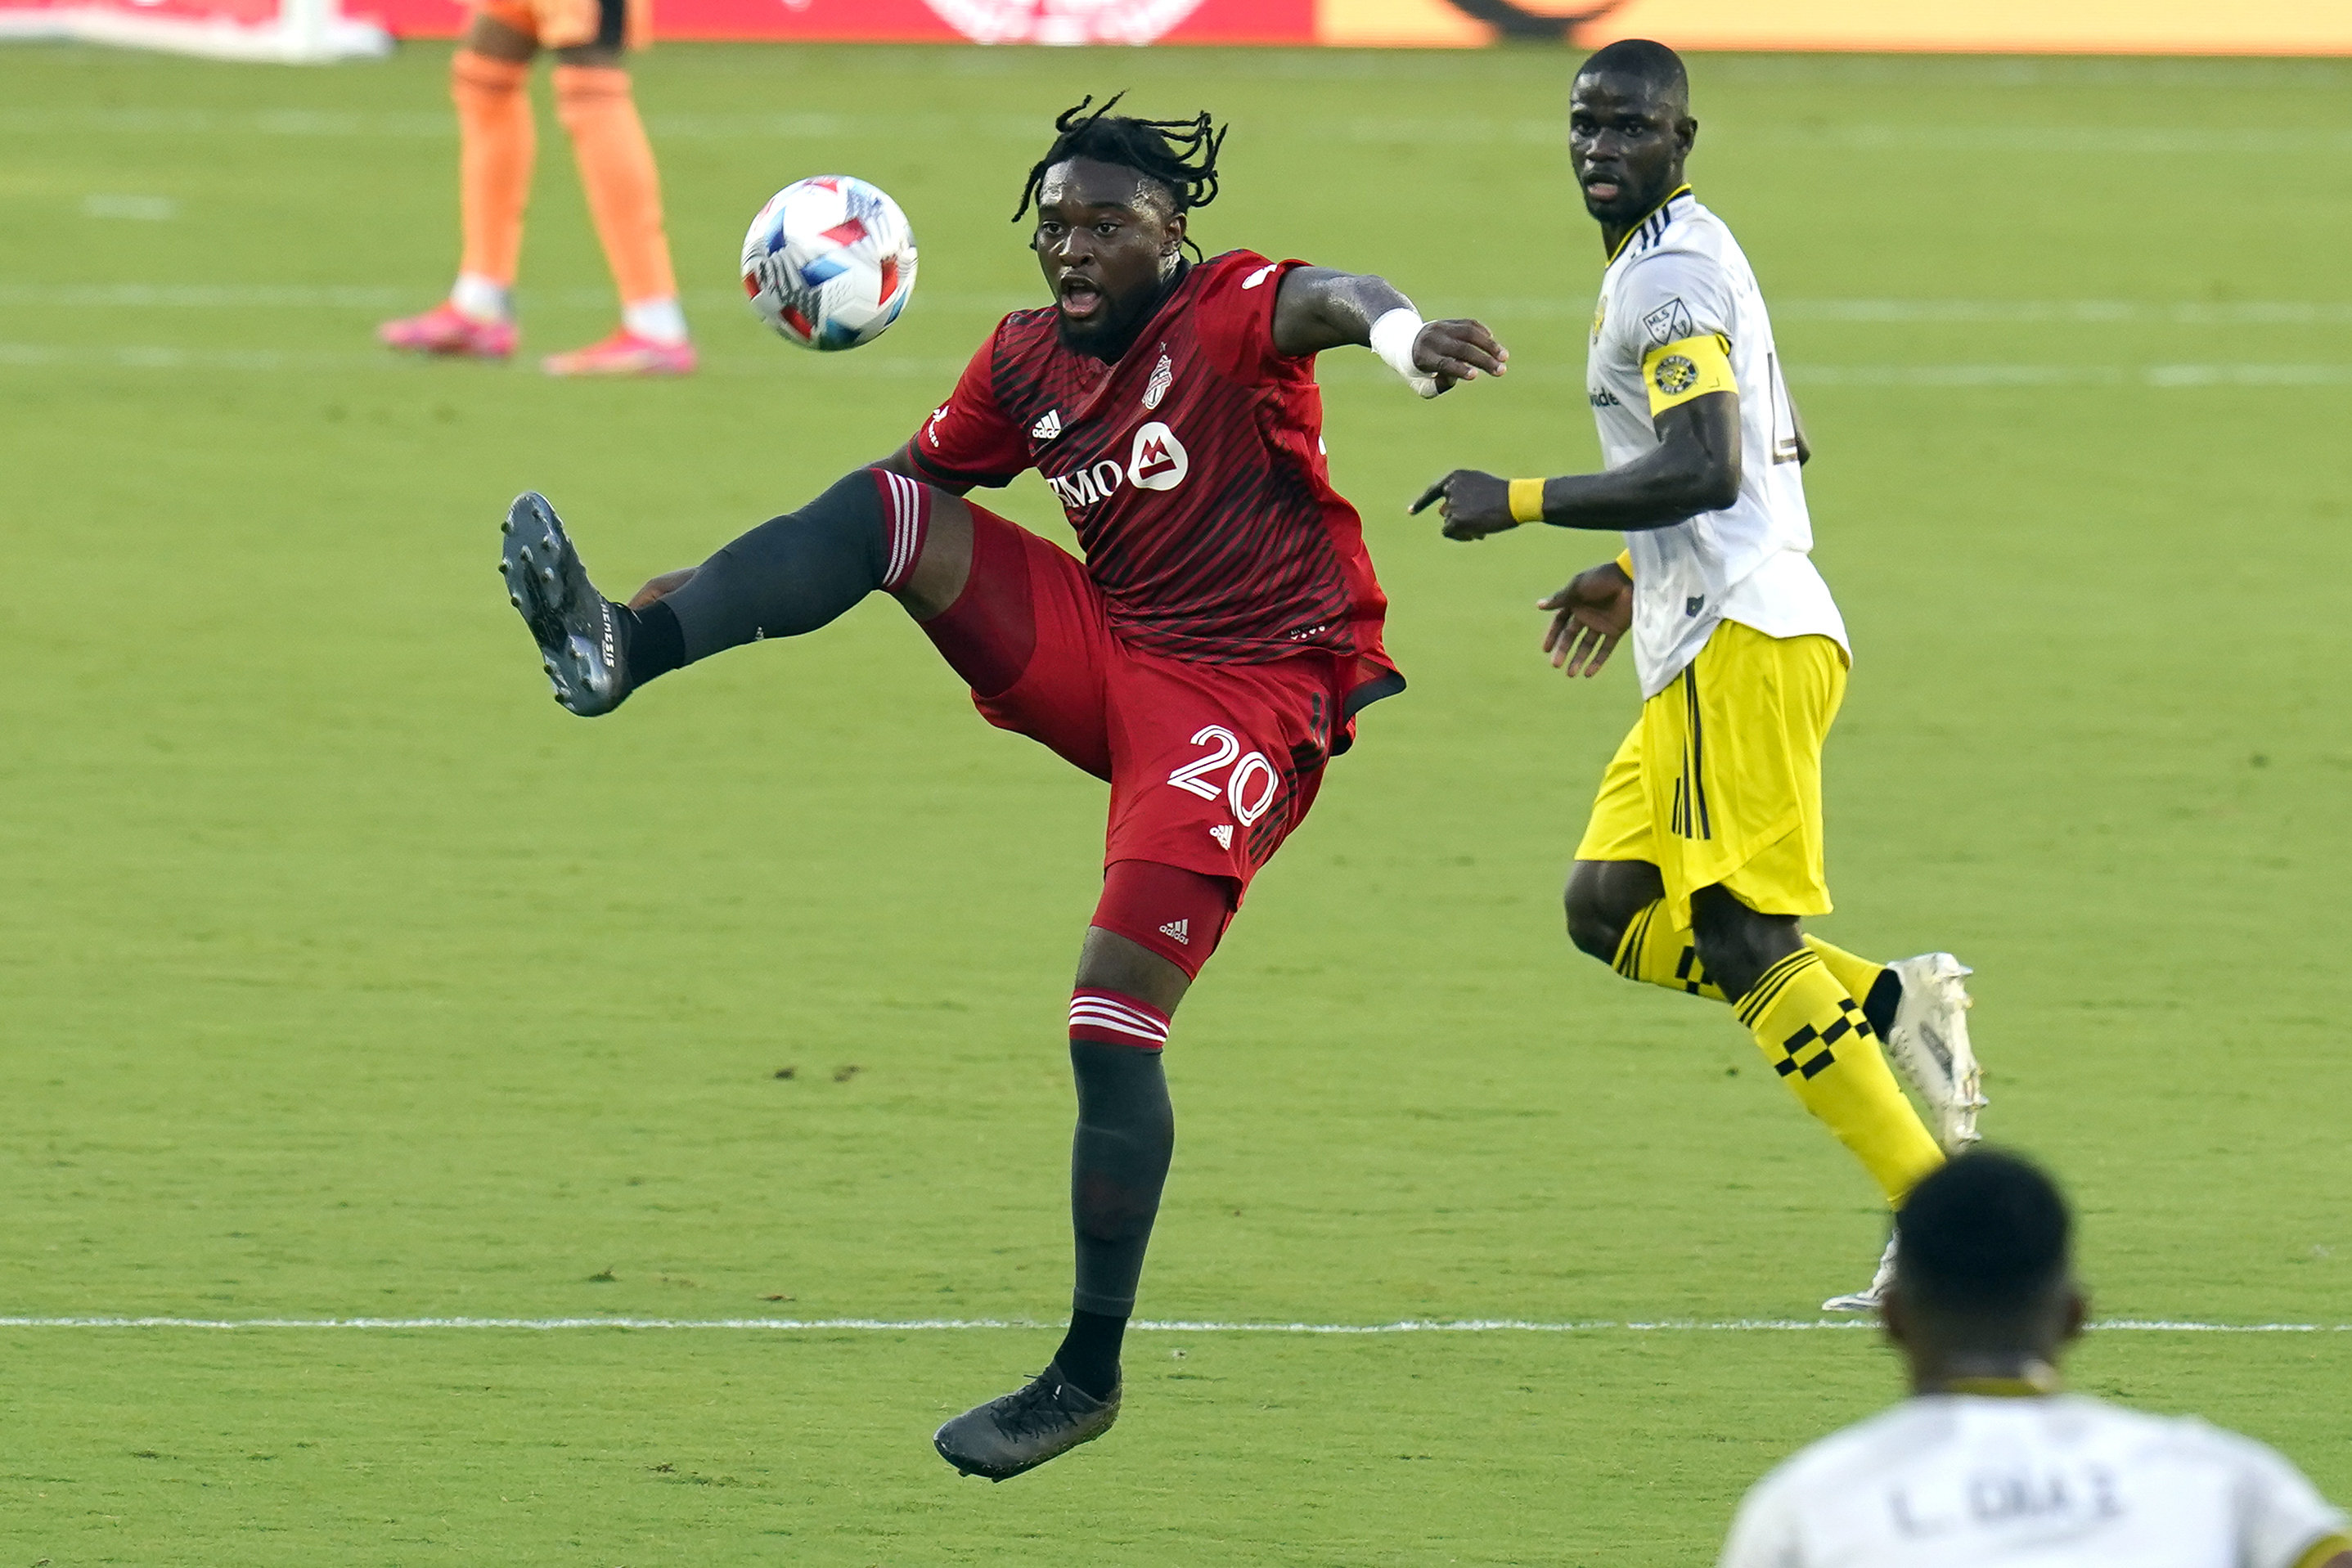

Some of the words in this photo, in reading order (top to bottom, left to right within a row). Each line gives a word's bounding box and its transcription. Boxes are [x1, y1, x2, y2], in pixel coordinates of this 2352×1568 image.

[1648, 308, 1670, 327] MLS
[1166, 724, 1279, 828] 20
[1158, 925, 1189, 946] adidas
